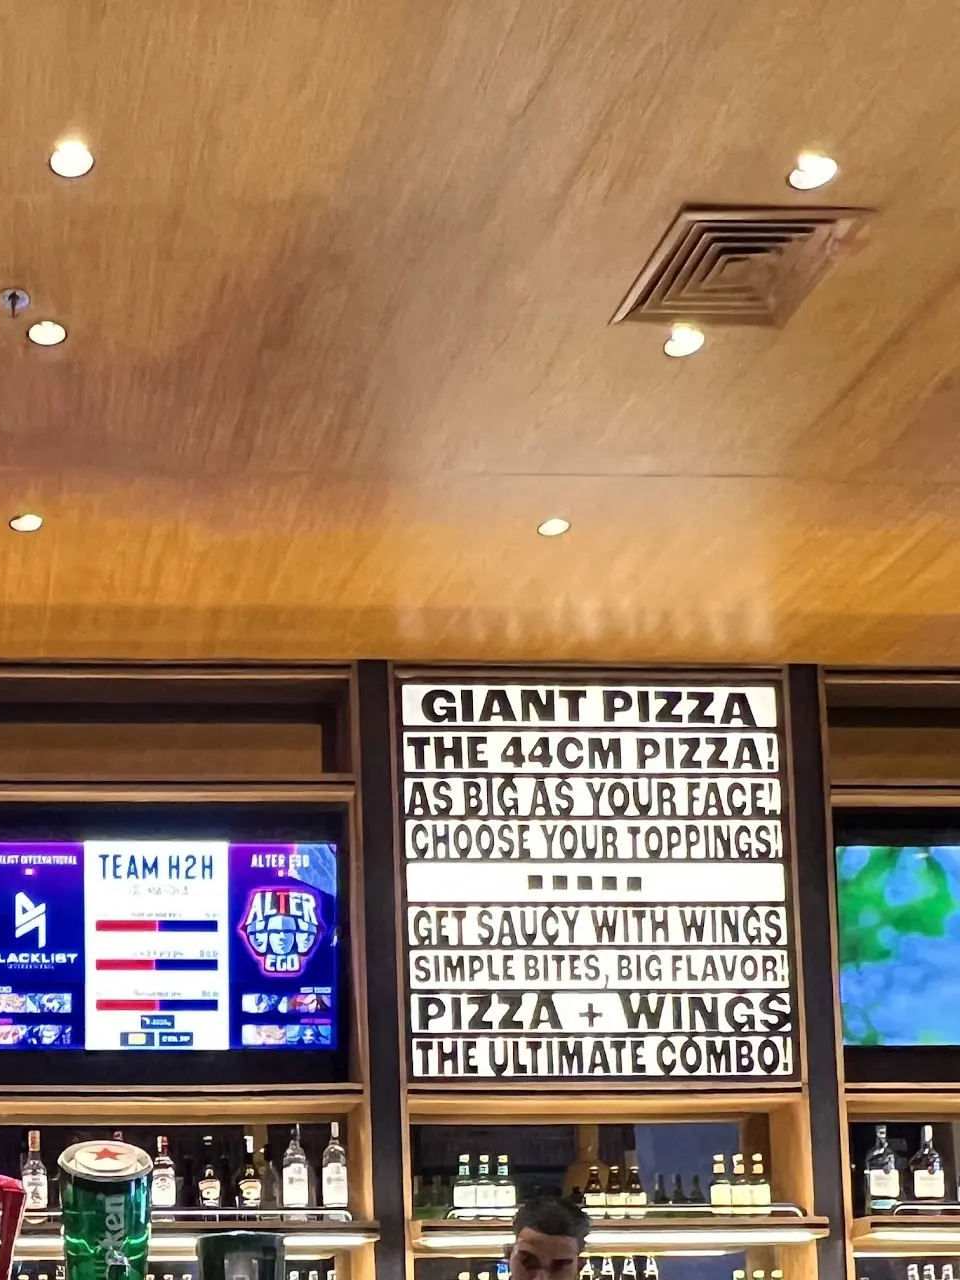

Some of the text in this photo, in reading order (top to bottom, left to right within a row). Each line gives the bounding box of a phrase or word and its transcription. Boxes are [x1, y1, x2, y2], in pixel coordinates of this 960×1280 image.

[421, 690, 756, 725] GIANT PIZZA
[407, 737, 775, 769] THE 44CM PIZZA!
[409, 782, 778, 815] AS BIG AS YOUR FACE!
[412, 825, 780, 858] CHOOSE YOUR TOPPINGS!
[98, 854, 213, 880] TEAM H2H
[251, 854, 285, 868] ALTER
[245, 891, 318, 925] ALTER
[413, 910, 781, 944] GET SAUCY WITH WINGS
[265, 955, 299, 972] EGO
[415, 955, 785, 988] SIMPLE BITES, BIG FLAVOR!
[418, 997, 790, 1029] PIZZA + WINGS
[417, 1041, 789, 1074] THE ULTIMATE COMBO!
